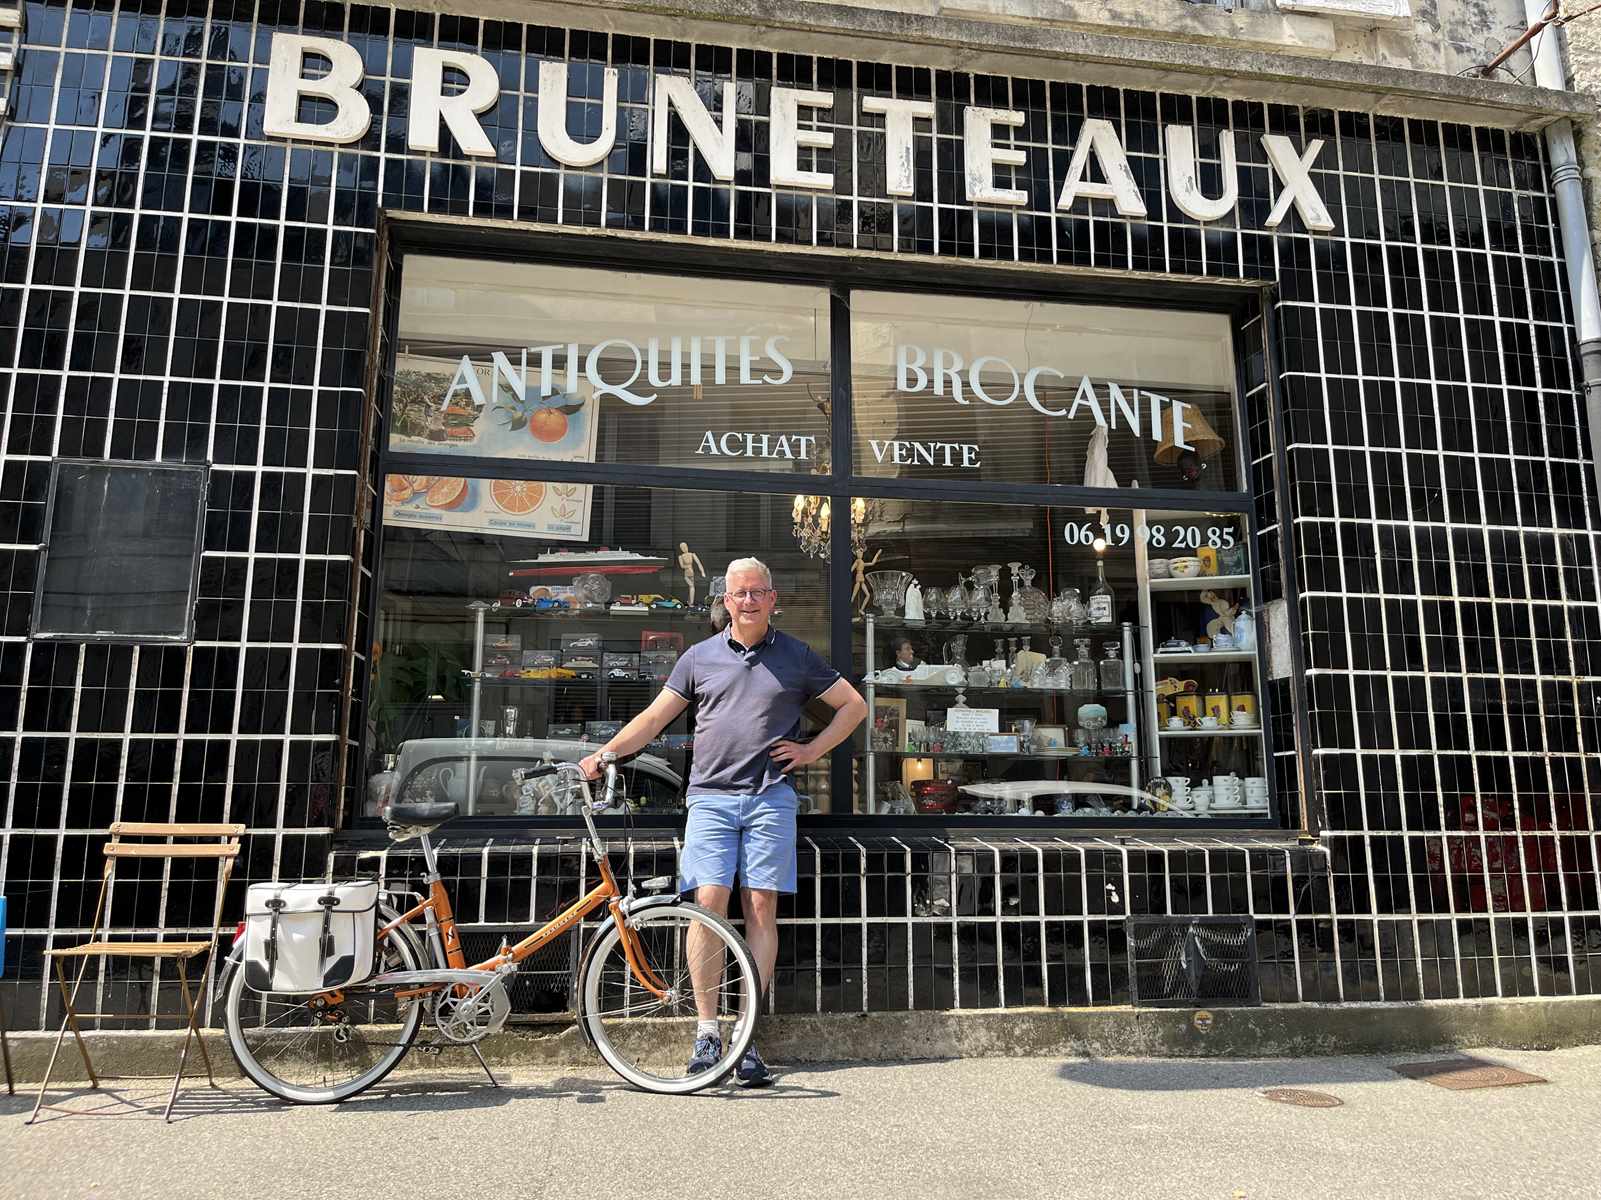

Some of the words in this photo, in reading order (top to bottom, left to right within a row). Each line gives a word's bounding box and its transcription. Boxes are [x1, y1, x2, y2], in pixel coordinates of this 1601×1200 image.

[263, 31, 1336, 232] BRUNETEAUX
[896, 343, 1196, 453] BROCANTE
[695, 429, 816, 460] ACHAT
[868, 439, 982, 468] VENTE
[1064, 521, 1095, 546] 06
[1101, 523, 1130, 546] 19
[1135, 523, 1166, 548] 98
[1171, 525, 1201, 549] 20
[1207, 525, 1235, 550] 85
